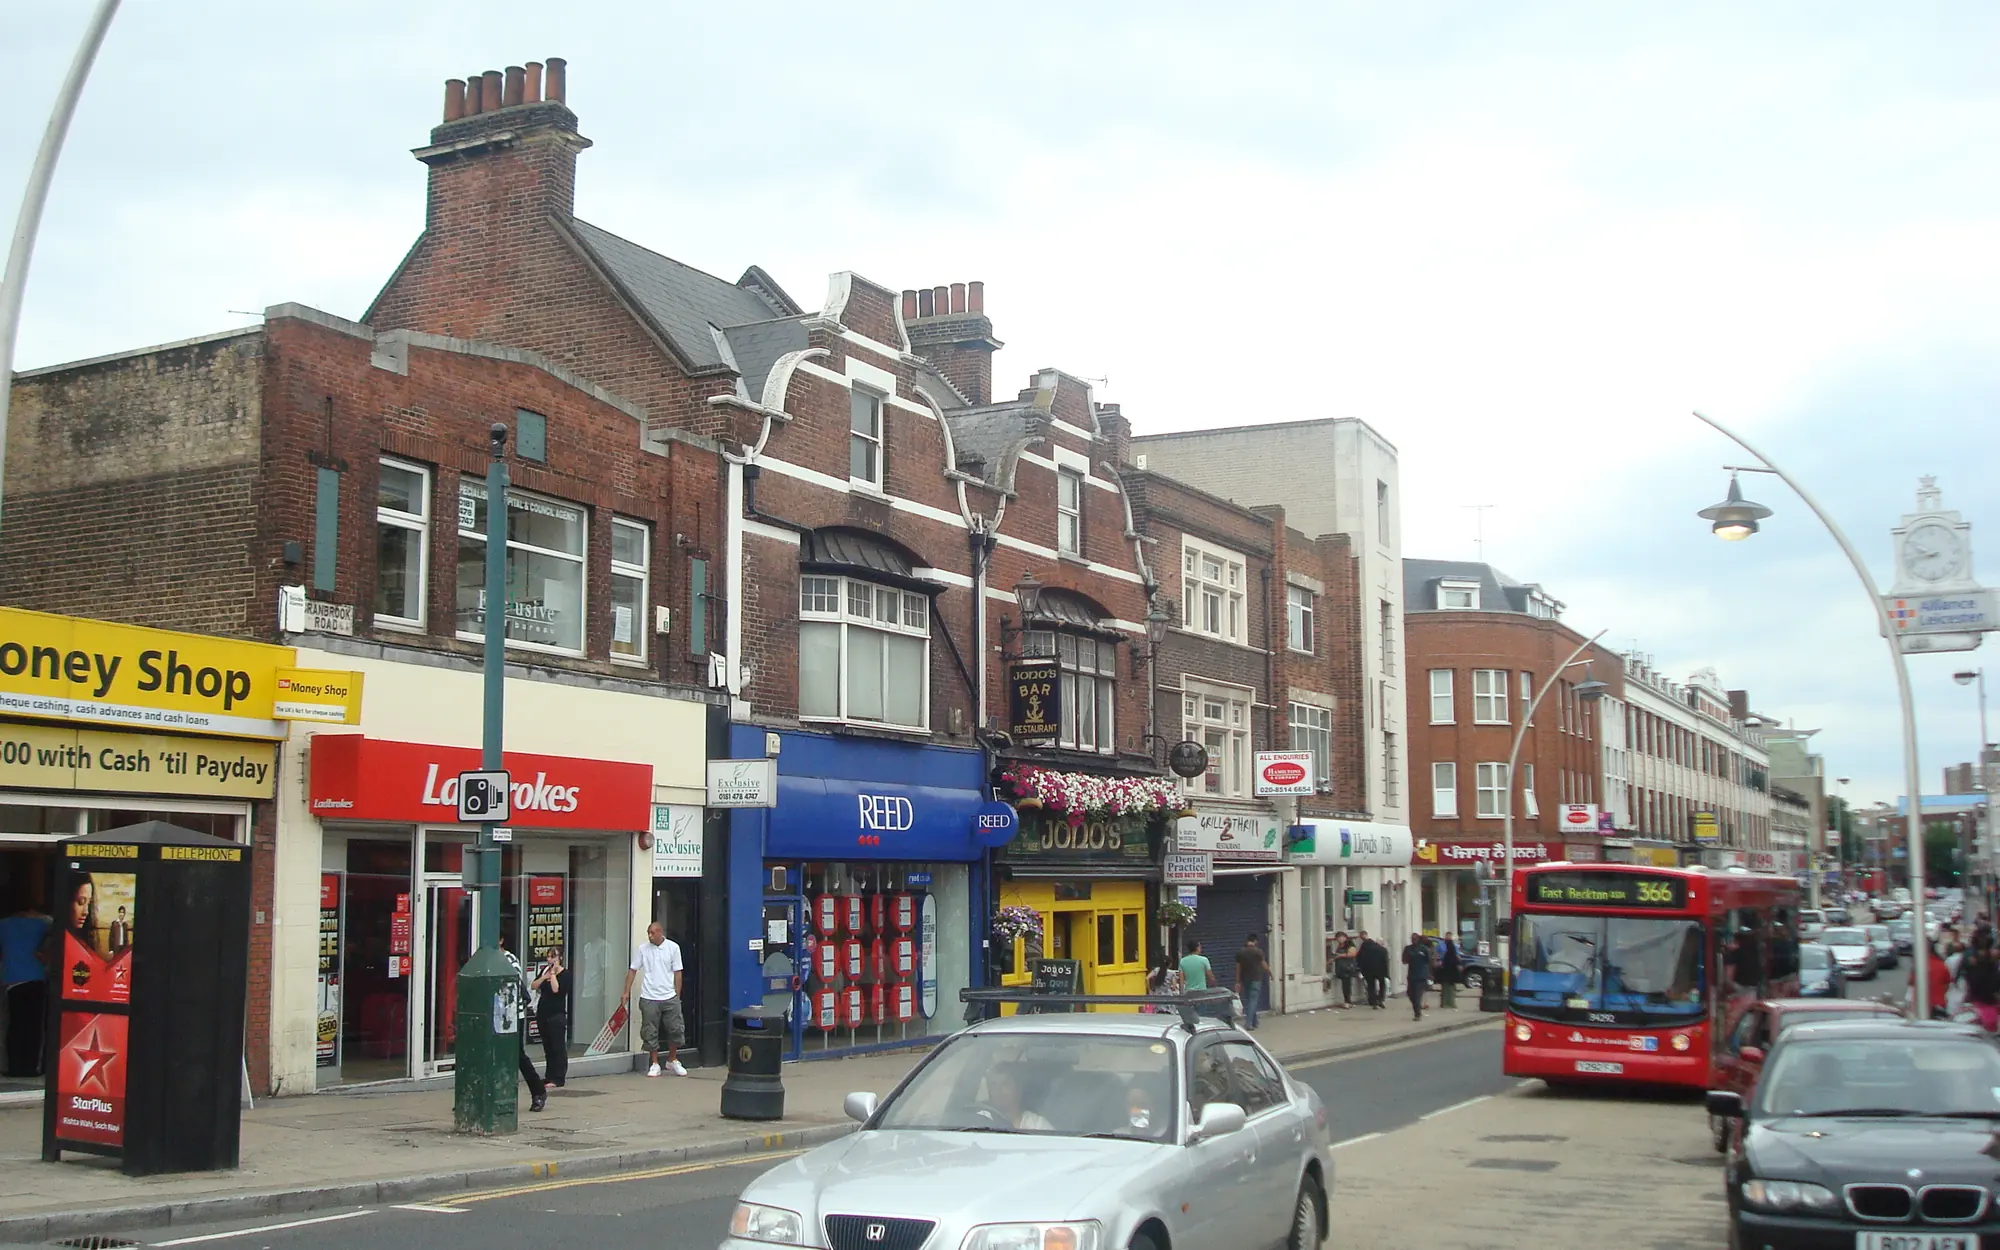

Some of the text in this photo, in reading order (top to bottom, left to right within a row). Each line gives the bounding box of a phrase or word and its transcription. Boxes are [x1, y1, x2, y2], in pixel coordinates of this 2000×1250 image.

[530, 502, 554, 517] COUNCIL
[555, 508, 578, 523] AGENCY
[304, 602, 351, 620] RANBROOK
[479, 589, 556, 621] Elusive
[315, 616, 338, 630] ROAD
[138, 650, 251, 711] Shop
[291, 683, 322, 696] Money
[324, 684, 348, 698] Shop
[1019, 683, 1051, 697] BAR
[76, 704, 97, 715] cash
[99, 705, 142, 720] advances
[144, 710, 162, 721] and
[163, 712, 183, 724] cash
[185, 713, 209, 726] loans
[1014, 723, 1057, 734] RESTAURANT
[0, 741, 31, 765] 00
[37, 744, 91, 768] with
[100, 746, 150, 773] Cash
[196, 754, 268, 785] Payday
[422, 763, 580, 813] Larokes
[718, 777, 760, 788] Exclusive
[314, 798, 354, 810] Ladbrokes
[858, 794, 914, 831] REED
[978, 814, 1010, 829] REED
[1200, 815, 1223, 830] GRILL
[1220, 816, 1234, 842] 2
[73, 844, 132, 857] TELEPHONE
[656, 837, 701, 854] Exclusive
[1353, 832, 1377, 859] Lloyds
[169, 847, 234, 860] TELEPHONE
[1175, 855, 1204, 863] Dental
[676, 864, 701, 872] bureau
[1168, 863, 1205, 872] Practice
[1540, 886, 1563, 898] East
[1567, 887, 1608, 900] Beckton
[1636, 881, 1673, 901] 366
[529, 913, 563, 925] 2 MILLION
[529, 925, 563, 947] FREE
[318, 1020, 337, 1033] £500
[72, 1096, 113, 1113] StarPlus
[94, 1121, 107, 1130] Soch
